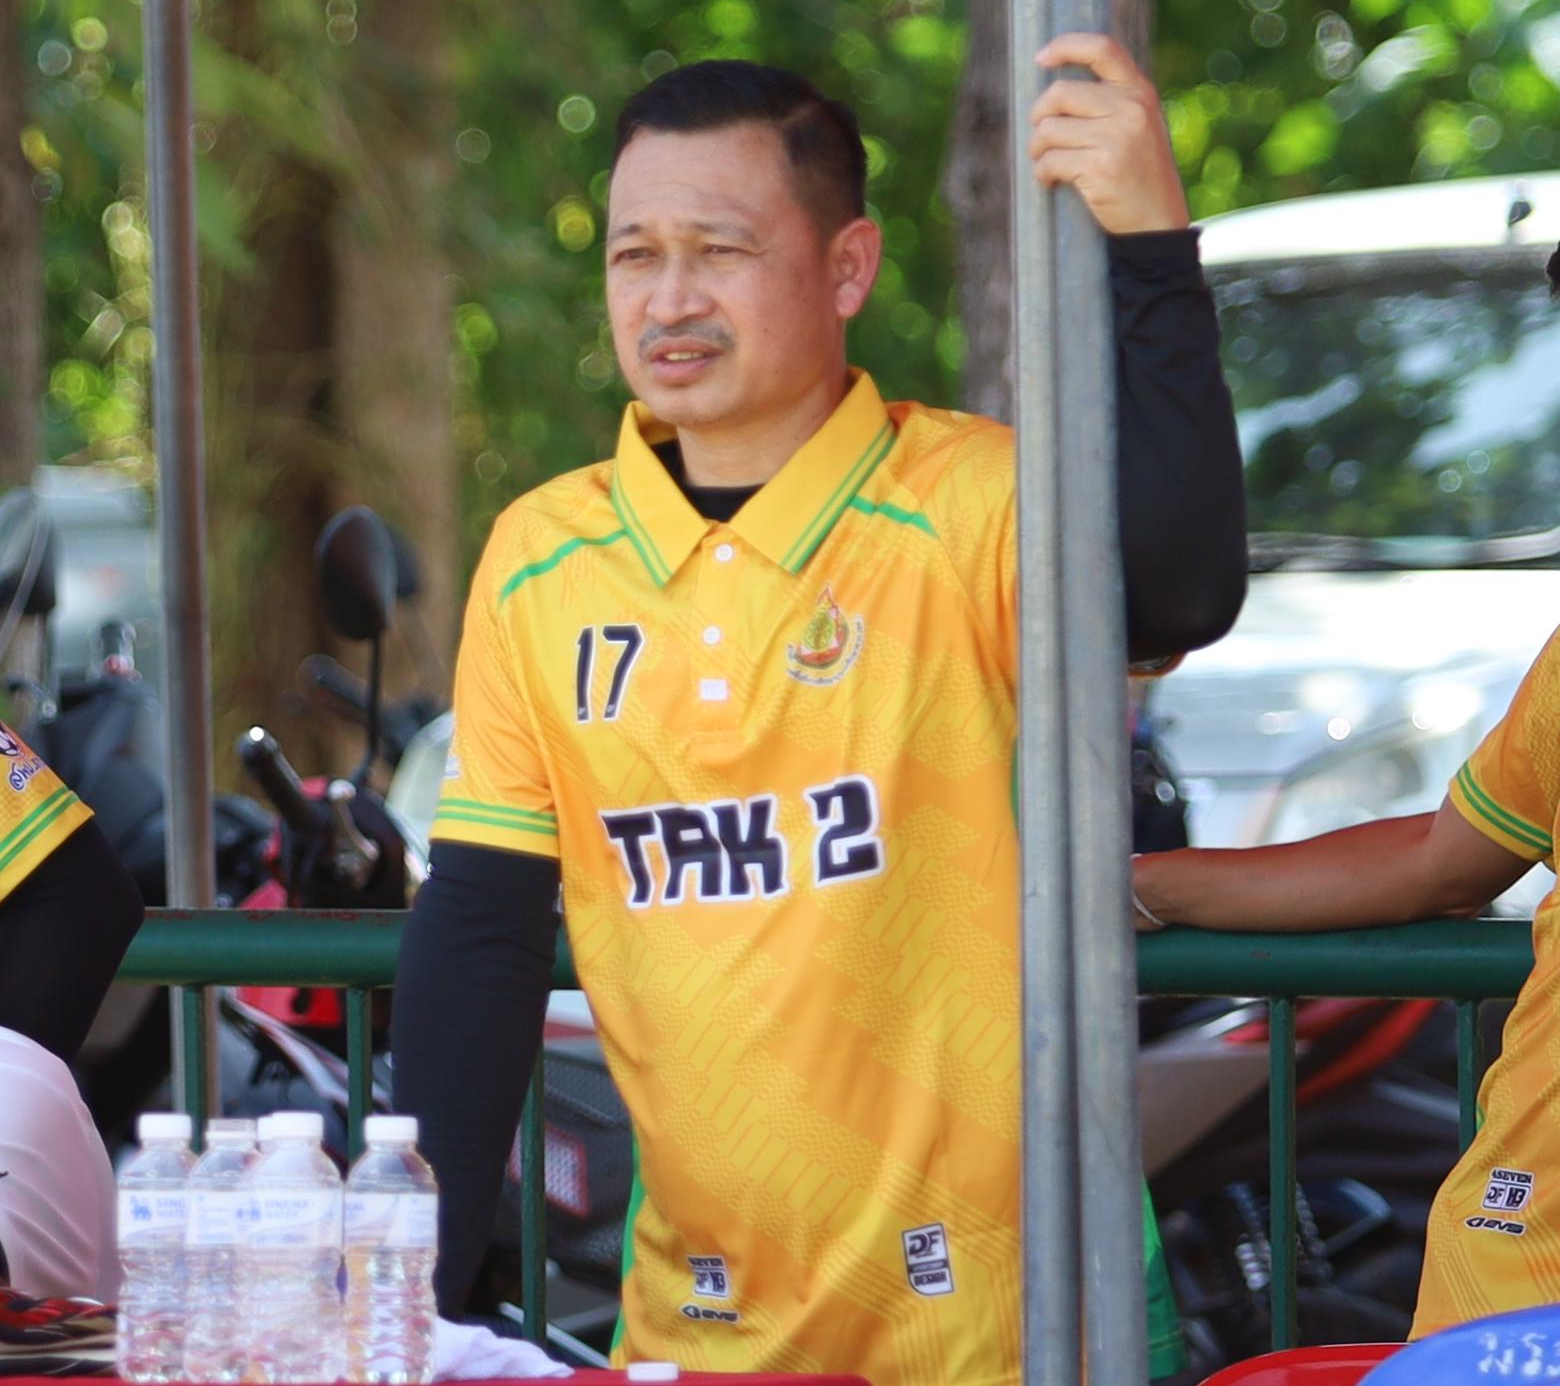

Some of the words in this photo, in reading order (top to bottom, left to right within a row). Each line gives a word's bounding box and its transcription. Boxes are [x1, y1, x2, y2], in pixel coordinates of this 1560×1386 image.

[576, 622, 645, 722] 17
[598, 793, 791, 909] TAK
[802, 773, 890, 889] 2
